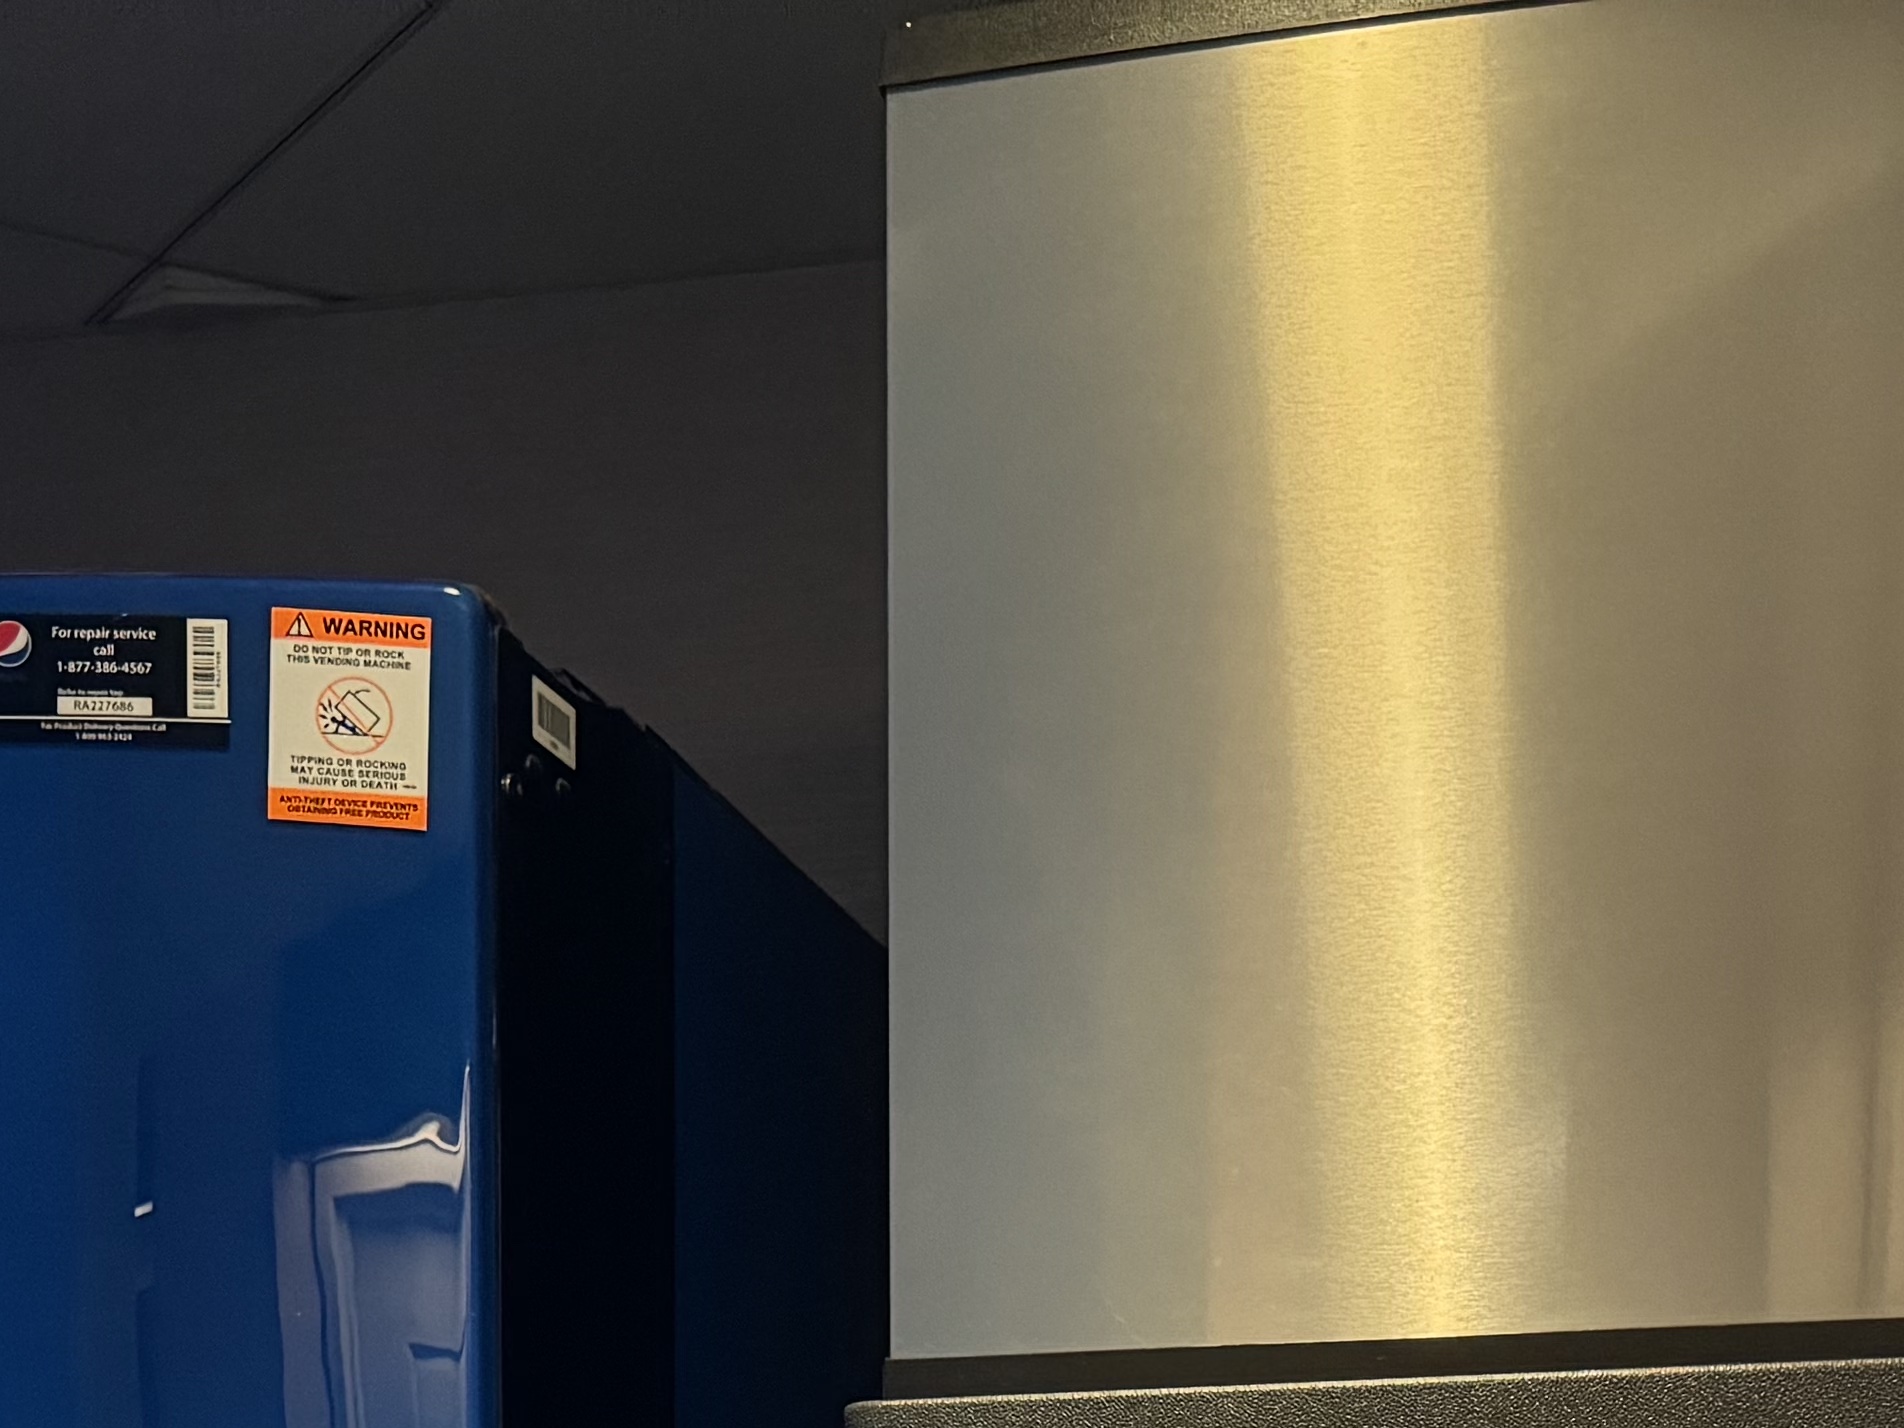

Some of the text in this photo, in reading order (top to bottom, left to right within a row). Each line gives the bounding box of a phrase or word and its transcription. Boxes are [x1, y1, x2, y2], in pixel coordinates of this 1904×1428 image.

[51, 626, 156, 642] For repair service
[323, 617, 426, 640] WARNING
[94, 644, 114, 656] call
[293, 644, 404, 659] DO NOT TIP OR ROCK
[287, 654, 411, 670] THIS VENDING MACHINE
[74, 700, 134, 712] RA227686
[291, 755, 406, 770] TIPPING OR ROCKING
[290, 765, 406, 781] MAY CAUSE SERIOUS
[298, 776, 397, 790] INJURY OR DEATH
